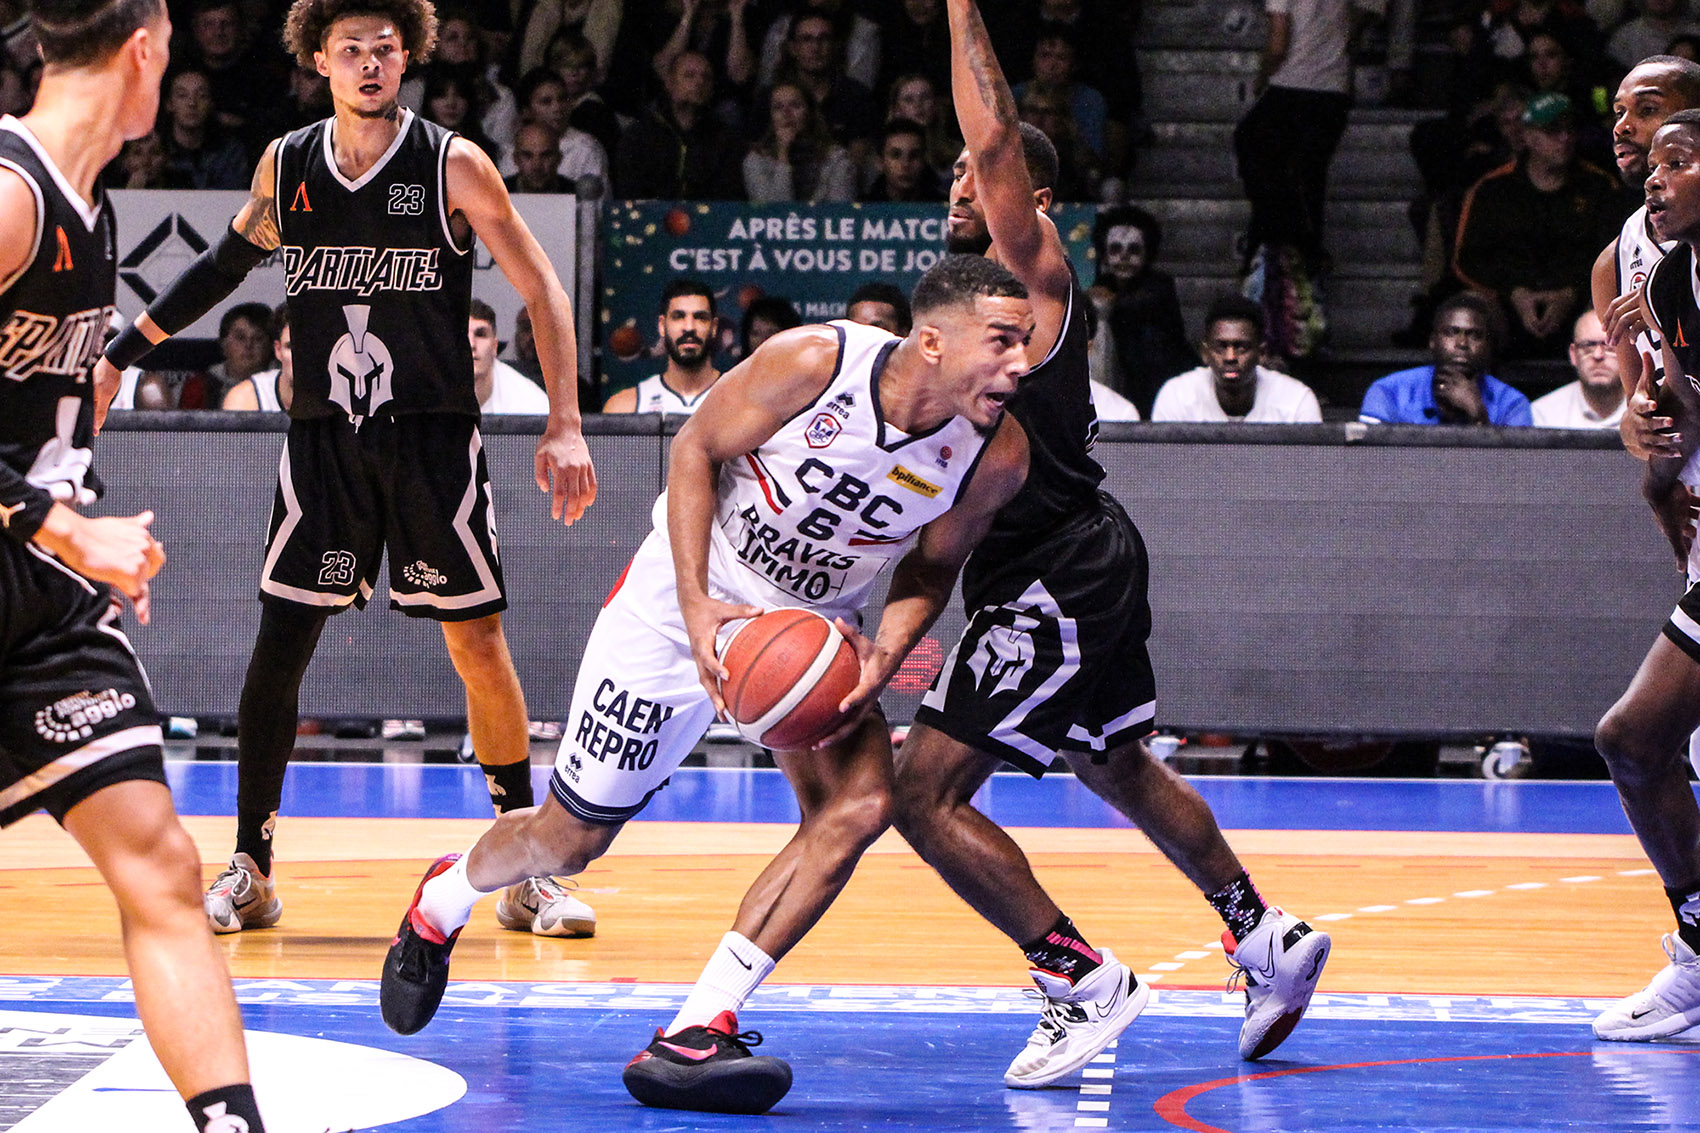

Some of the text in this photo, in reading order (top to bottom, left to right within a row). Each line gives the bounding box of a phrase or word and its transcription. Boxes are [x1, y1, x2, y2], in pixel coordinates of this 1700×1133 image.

[388, 183, 426, 215] 23
[728, 212, 817, 240] APRÈS
[825, 218, 855, 240] LE
[669, 248, 743, 271] C'EST
[748, 242, 768, 271] À
[774, 249, 851, 271] VOUS
[859, 249, 896, 271] DE
[795, 458, 903, 529] CBC
[891, 466, 938, 494] bpifrance
[740, 503, 861, 570] BRAVIS
[797, 507, 842, 540] 6
[318, 550, 356, 586] 23
[737, 528, 831, 600] IMMO
[70, 688, 136, 725] agglo
[593, 678, 674, 734] CAEN
[575, 710, 659, 772] REPRO
